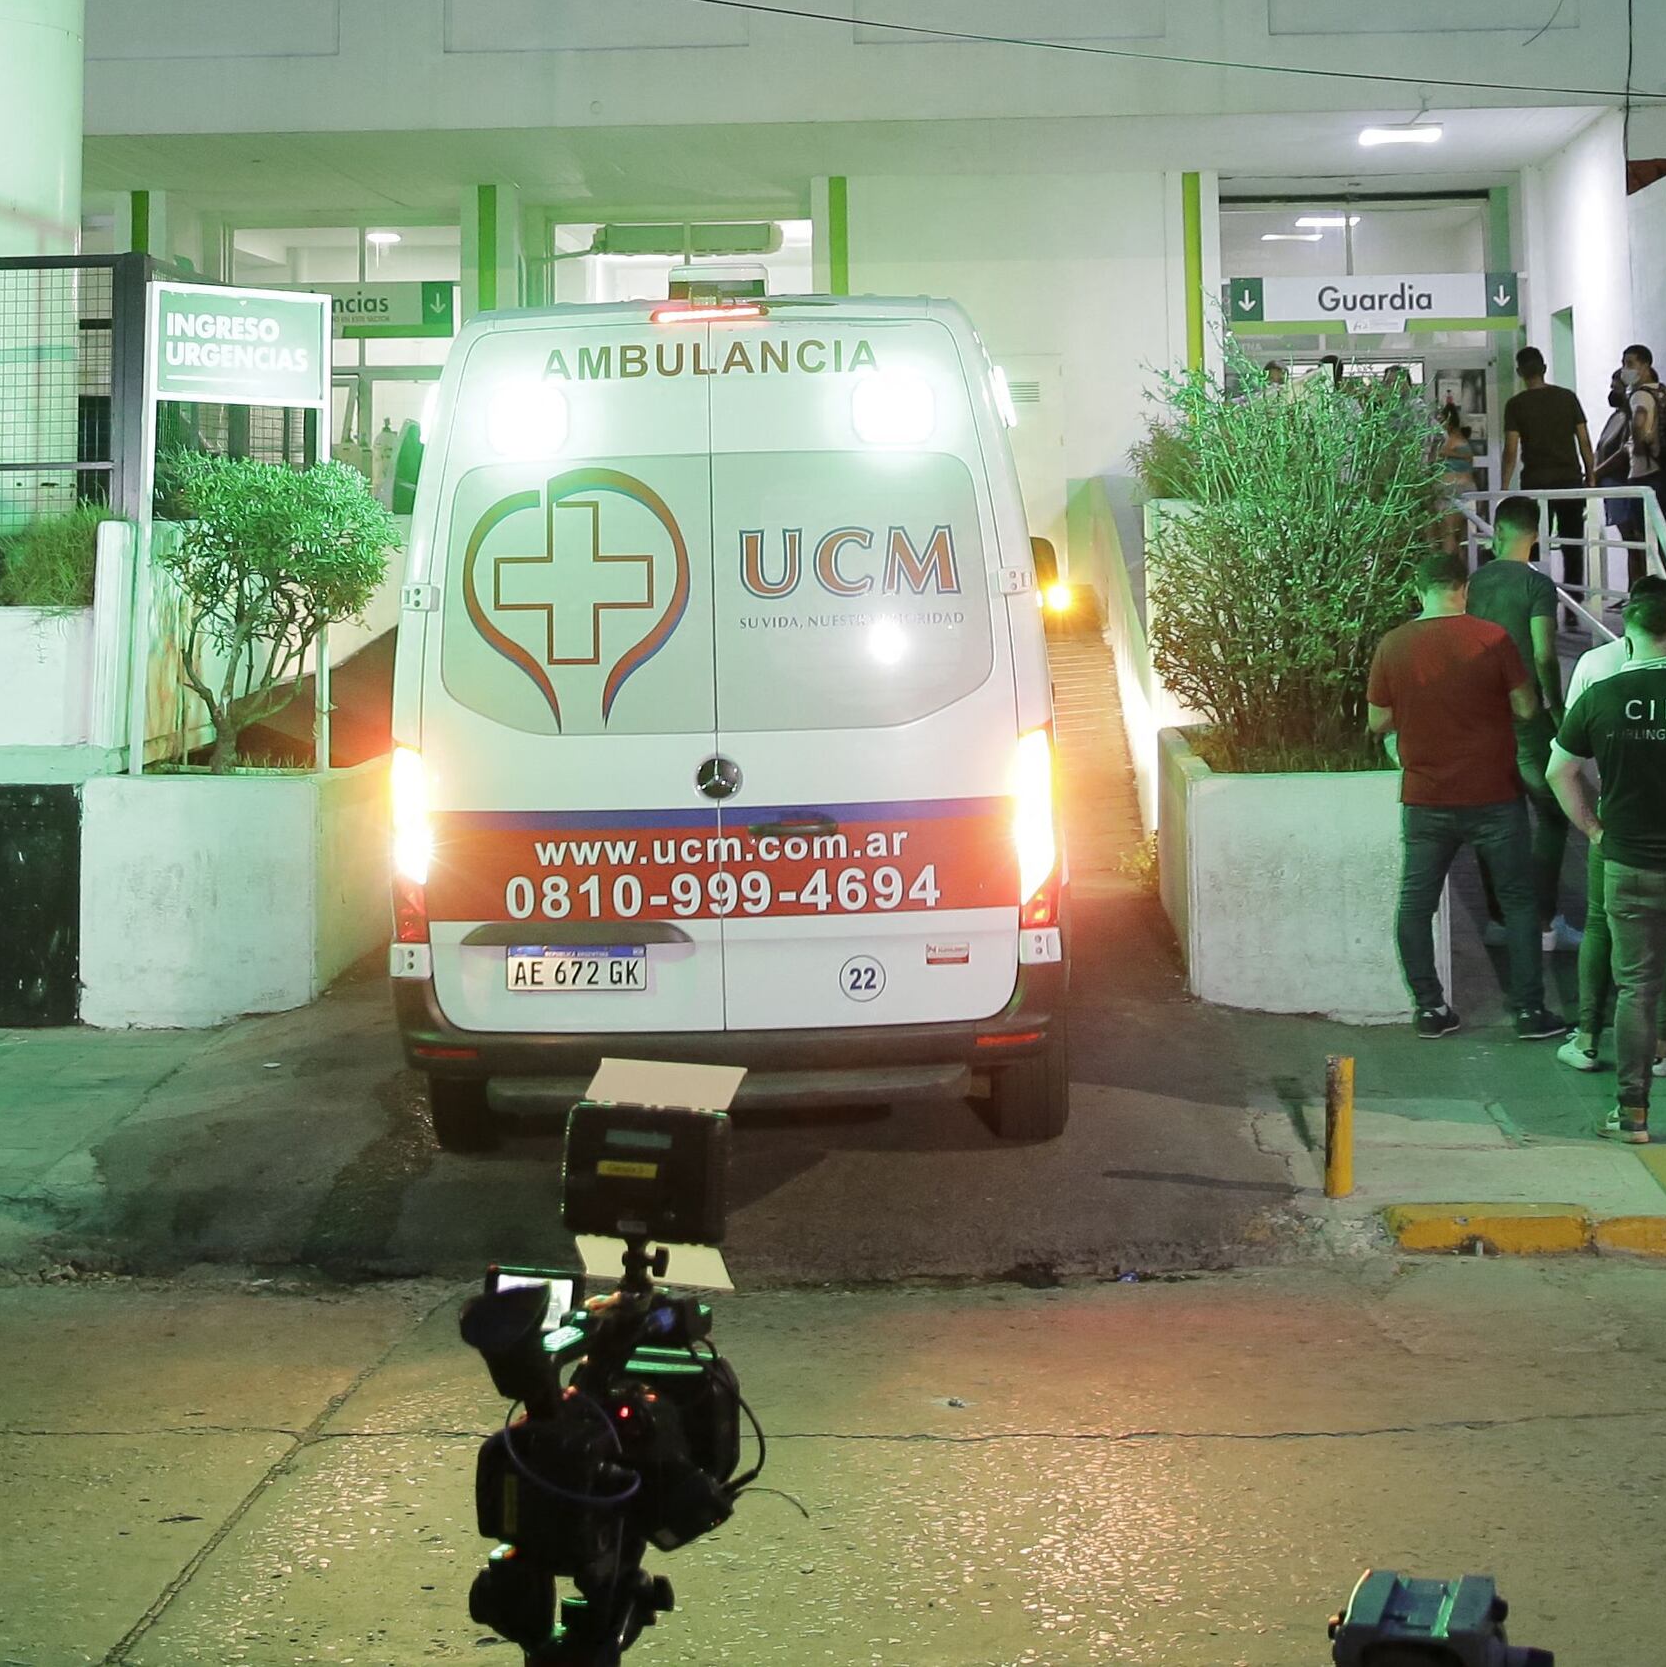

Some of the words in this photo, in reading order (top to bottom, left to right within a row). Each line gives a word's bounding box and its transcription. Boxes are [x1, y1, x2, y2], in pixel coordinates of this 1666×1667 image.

[1318, 283, 1433, 312] Guardia
[166, 312, 280, 343] INGRESO
[165, 341, 309, 372] URGENCIAS
[542, 338, 880, 382] AMBULANCIA
[738, 524, 962, 600] UCM
[739, 617, 759, 630] SU
[761, 615, 803, 630] VIDA,
[534, 826, 908, 867] www.ucm.com.ar
[504, 864, 942, 919] 0810-999-4694
[514, 961, 544, 985] AE
[554, 961, 599, 985] 672
[609, 960, 639, 985] GK
[849, 967, 877, 991] 22
